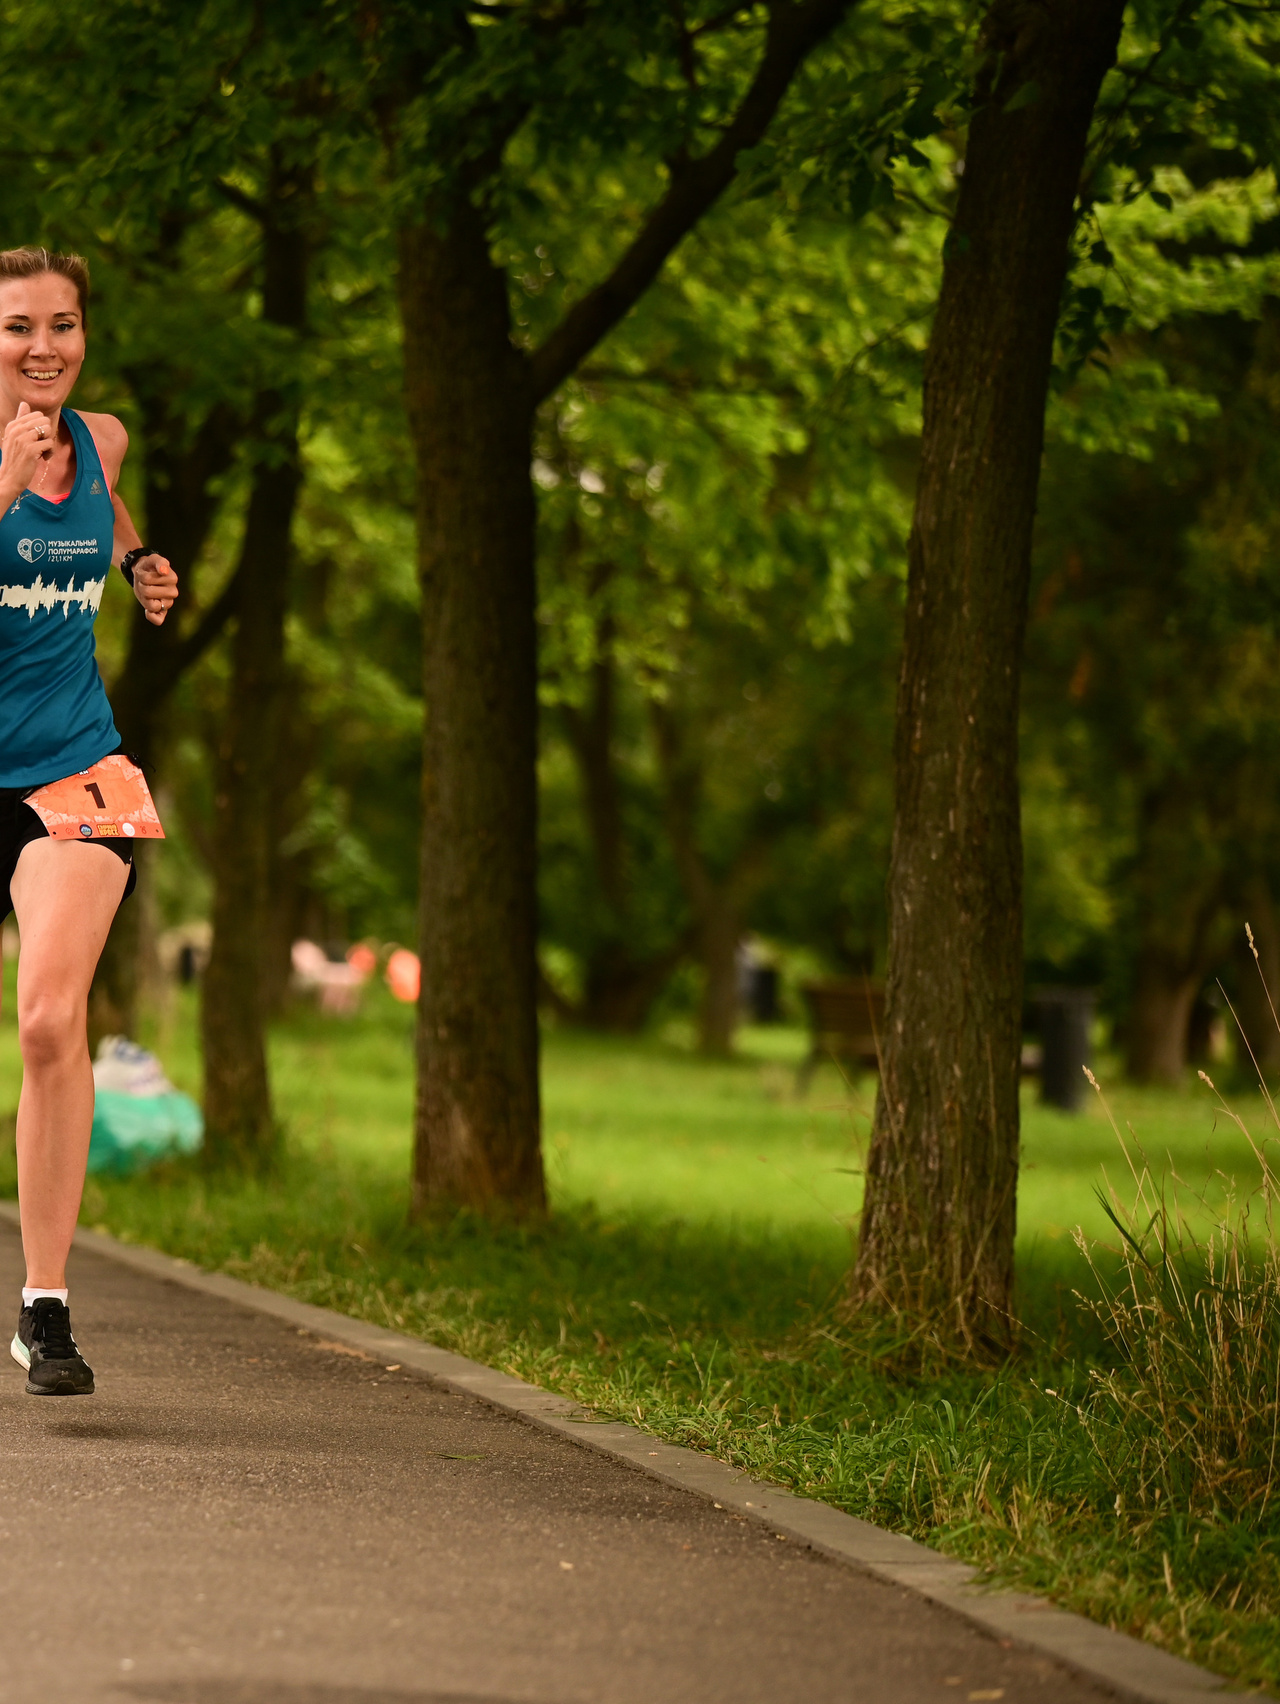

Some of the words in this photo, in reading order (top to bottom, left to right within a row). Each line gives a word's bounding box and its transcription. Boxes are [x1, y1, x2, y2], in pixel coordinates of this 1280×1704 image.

[48, 538, 97, 547] МУЗЫКАЛЬНЫЙ
[48, 547, 98, 555] ПОЛУМАРАФОН
[83, 782, 106, 809] 1
